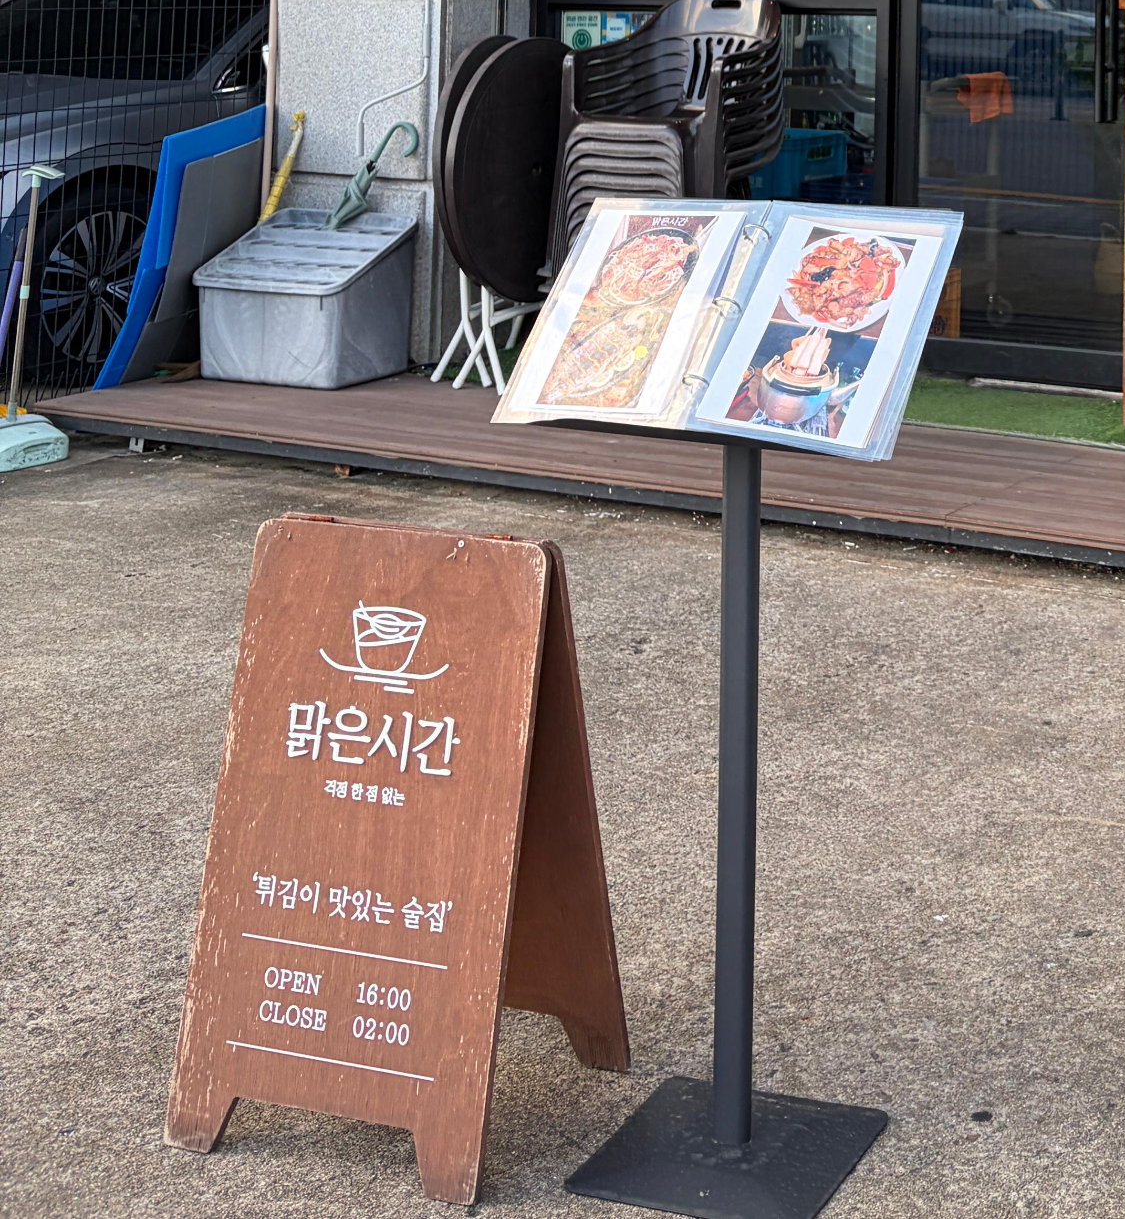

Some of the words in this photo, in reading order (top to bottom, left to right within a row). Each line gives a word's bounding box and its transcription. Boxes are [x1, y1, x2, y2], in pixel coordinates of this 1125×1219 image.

[286, 700, 461, 776] 맑은시간
[324, 779, 348, 799] 걱정
[351, 783, 363, 801] 한
[366, 785, 378, 803] 점
[381, 786, 405, 807] 없는
[328, 885, 395, 925] 맛있는
[264, 966, 321, 996] OPEN
[356, 981, 411, 1011] 16:00
[259, 999, 328, 1032] CLOSE
[352, 1015, 410, 1046] 02:00
